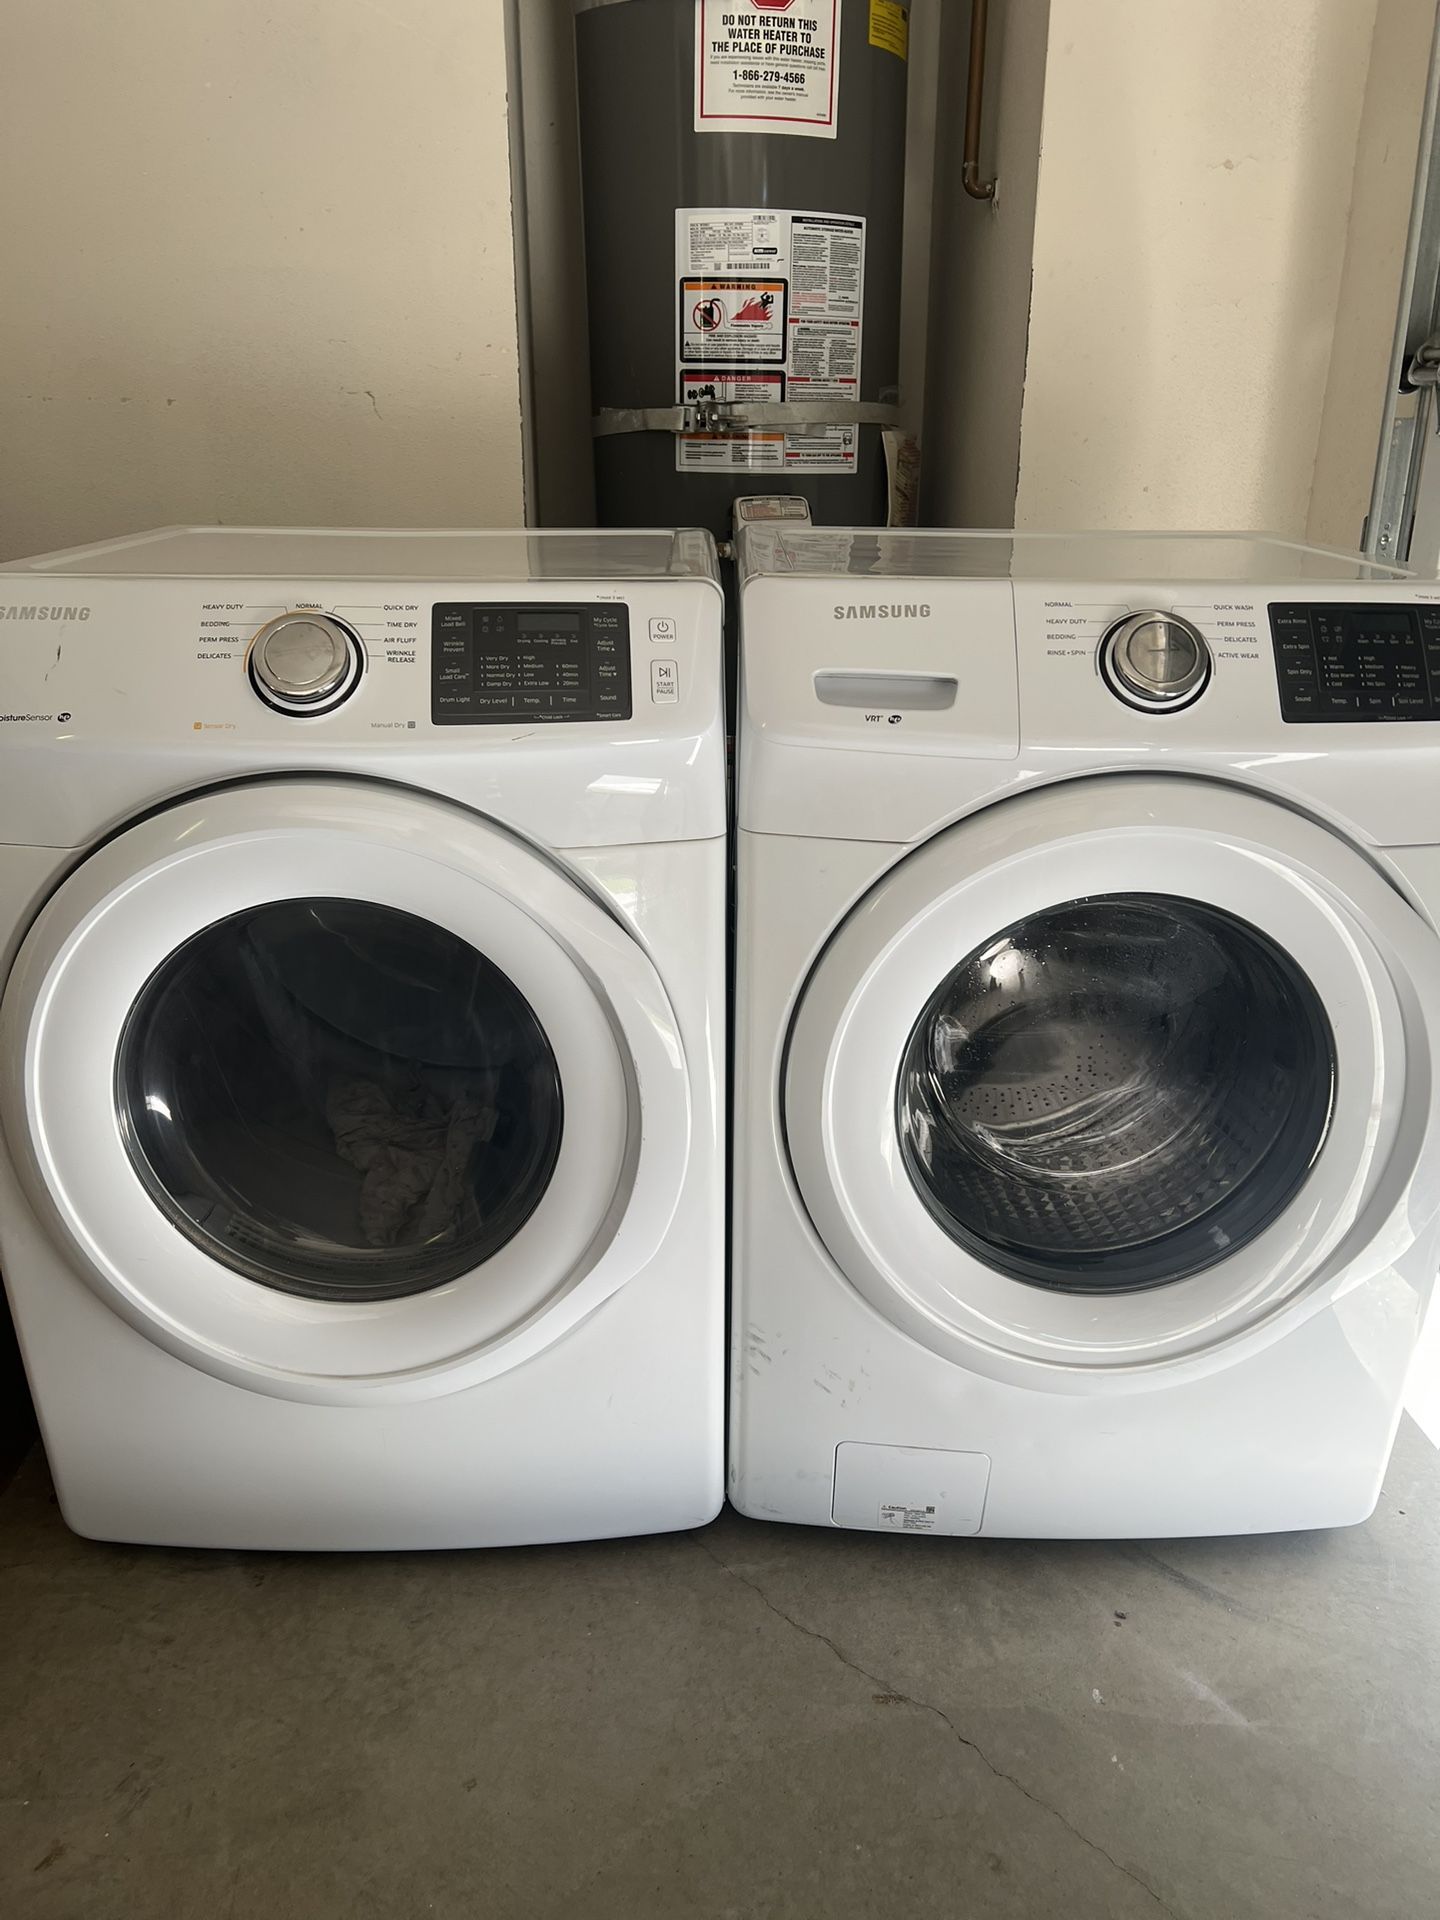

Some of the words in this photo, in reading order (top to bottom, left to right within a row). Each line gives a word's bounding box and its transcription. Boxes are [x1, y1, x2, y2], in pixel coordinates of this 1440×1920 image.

[722, 15, 734, 25] DO
[738, 15, 756, 26] NOT
[760, 16, 795, 28] RETURN
[798, 19, 817, 31] THIS
[728, 28, 760, 39] WATER
[763, 30, 797, 42] HEATER
[801, 33, 811, 44] TO
[712, 42, 729, 52] THE
[733, 42, 762, 53] PLACE
[765, 43, 776, 54] OF
[780, 44, 825, 58] PURCHASE
[733, 70, 805, 84] 1-866-279-4566
[834, 604, 930, 620] SAMSUNG
